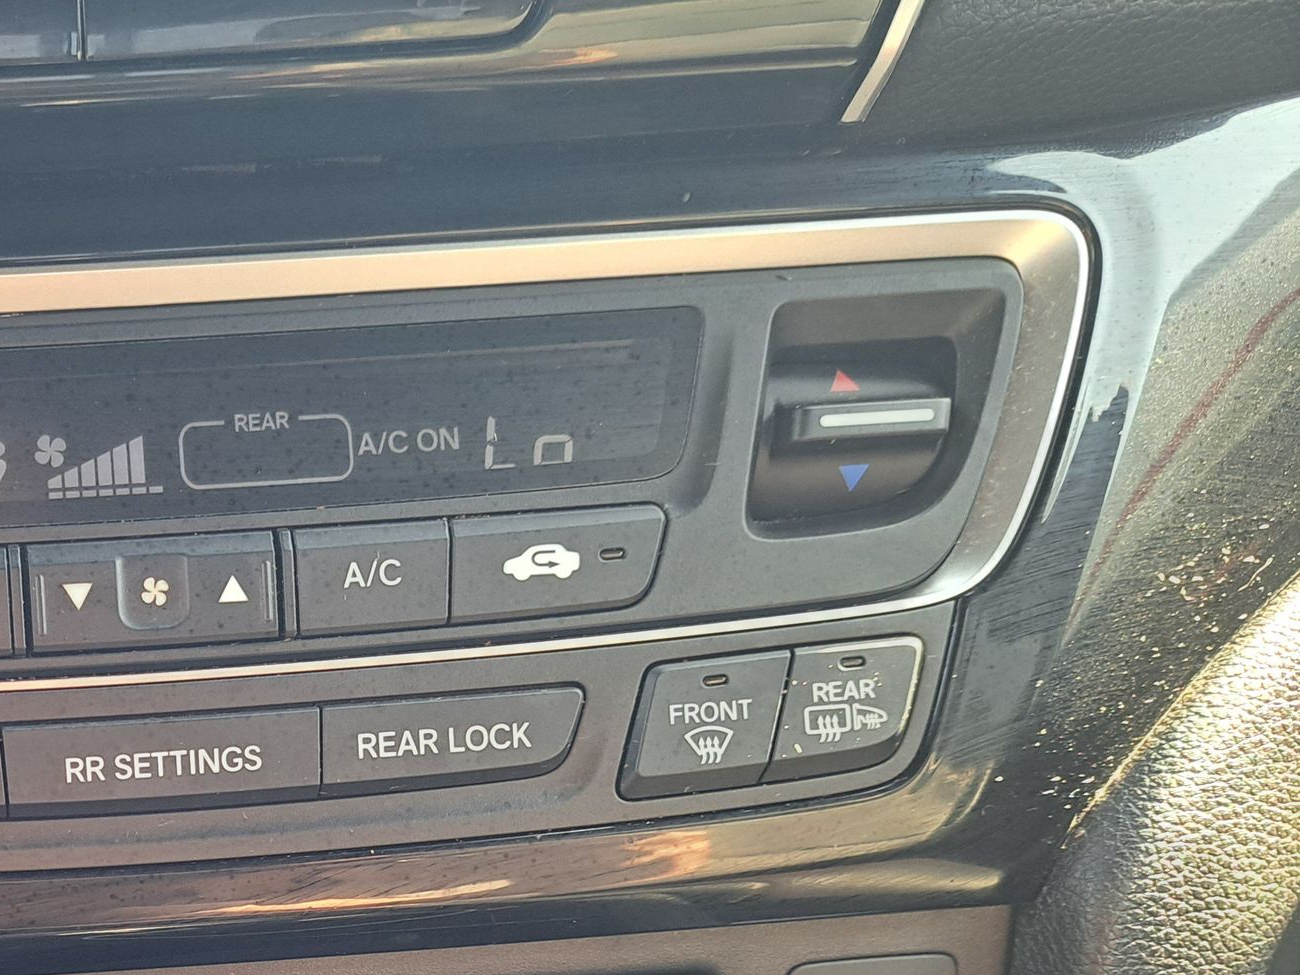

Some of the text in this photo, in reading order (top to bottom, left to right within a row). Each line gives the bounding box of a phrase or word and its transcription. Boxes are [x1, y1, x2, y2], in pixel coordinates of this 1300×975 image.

[233, 410, 290, 434] REAR
[357, 426, 460, 456] A/C ON
[342, 558, 403, 590] A/C
[811, 678, 877, 703] REAR
[668, 698, 753, 726] FRONT
[356, 721, 533, 760] REAR LOCK
[63, 744, 263, 784] RR SETTINGS
